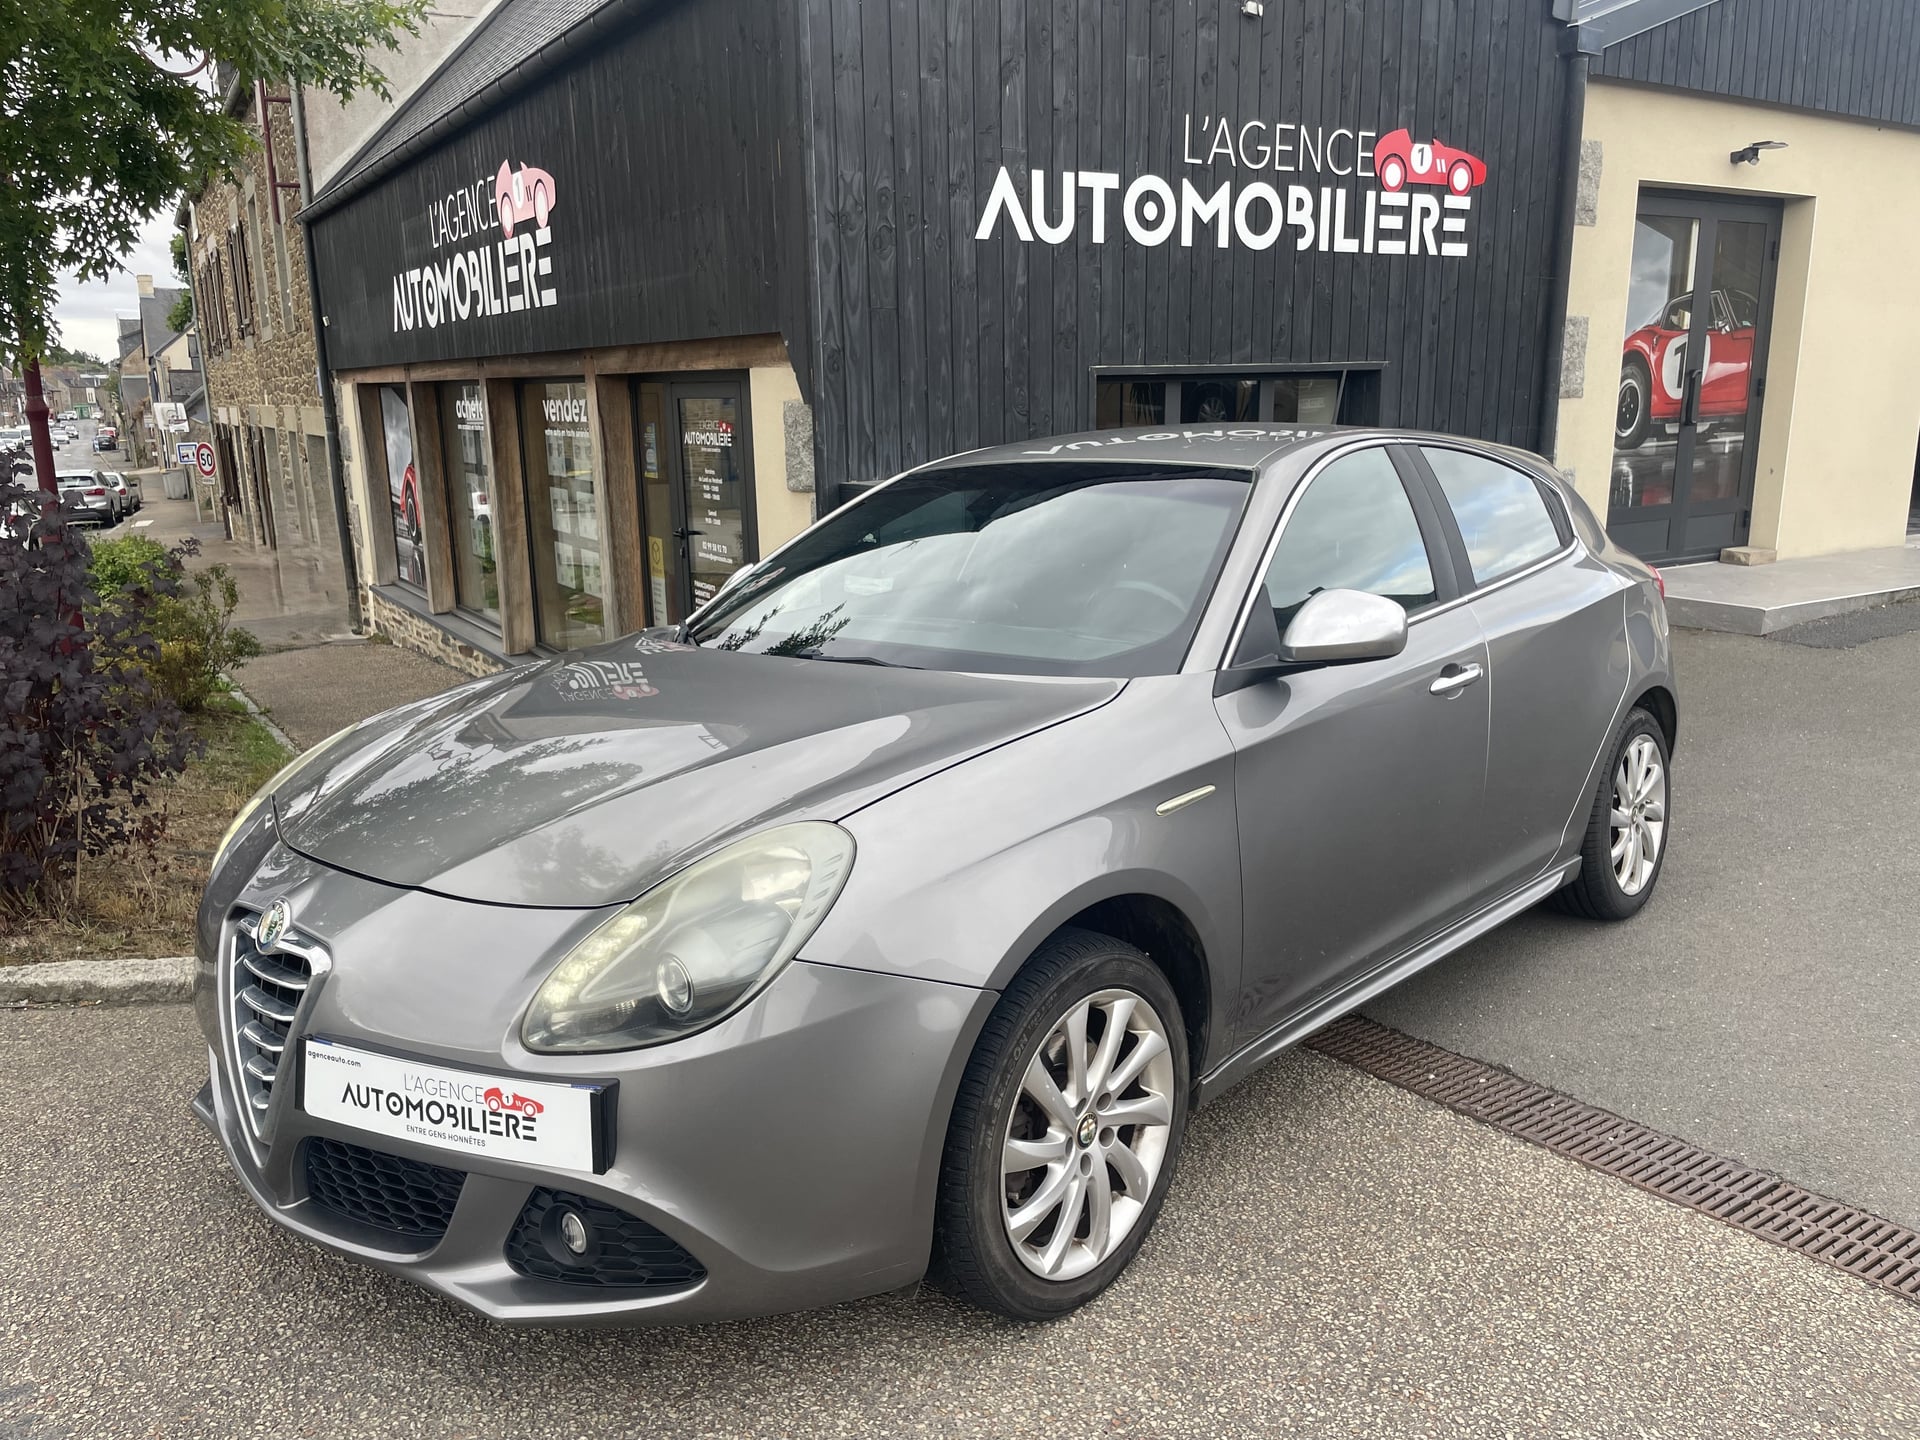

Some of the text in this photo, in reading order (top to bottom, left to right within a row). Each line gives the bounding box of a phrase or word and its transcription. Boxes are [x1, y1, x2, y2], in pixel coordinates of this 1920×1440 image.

[1183, 113, 1376, 177] L'AGENCE
[429, 175, 499, 249] L'AGENCE
[542, 384, 588, 422] vendez
[200, 453, 213, 467] 50
[308, 1050, 362, 1068] agenceauto.com
[403, 1072, 484, 1105] L'AGENCE
[406, 1124, 486, 1147] ENTRE GENS HONNÊTES
